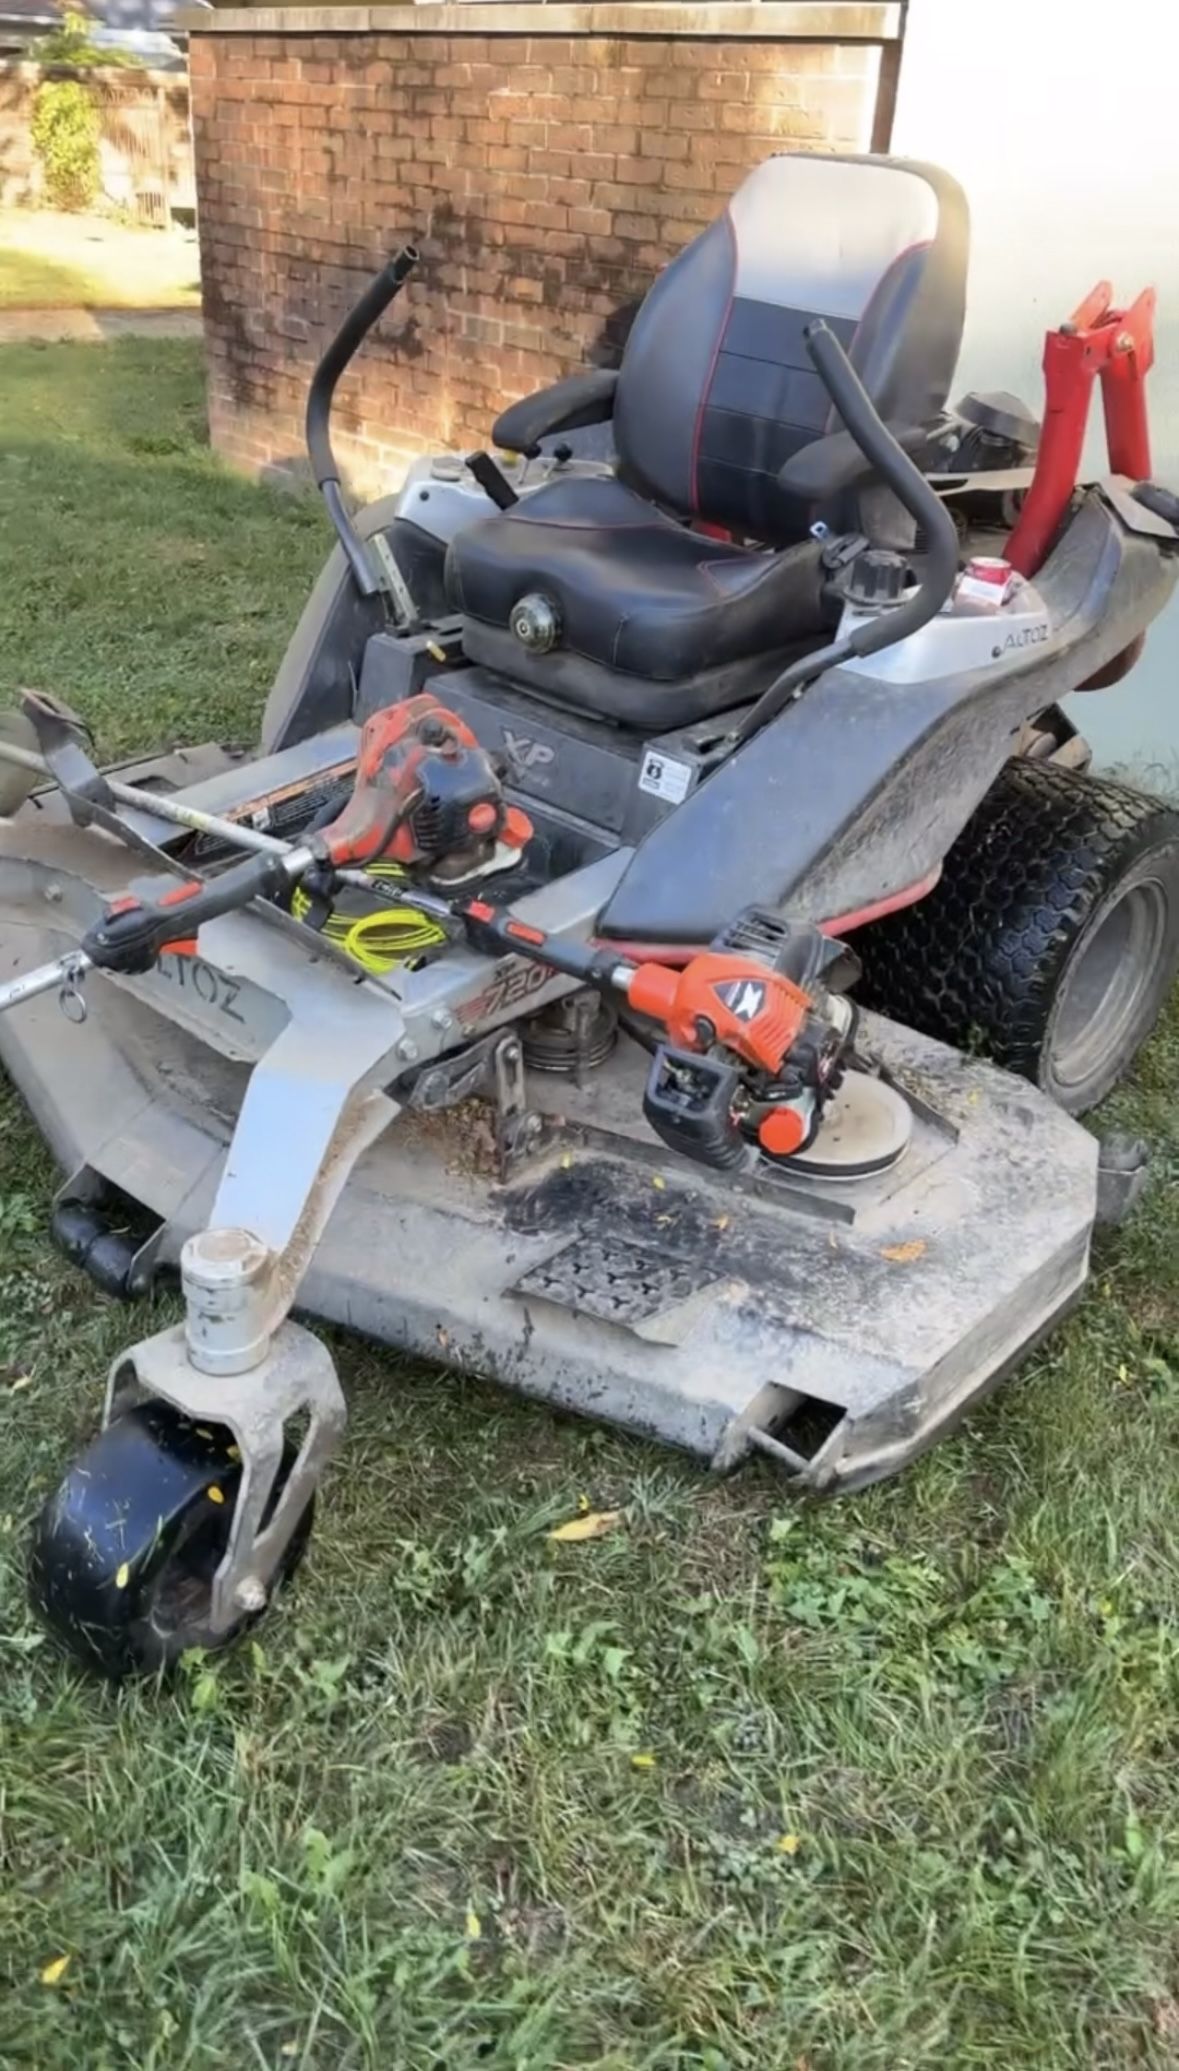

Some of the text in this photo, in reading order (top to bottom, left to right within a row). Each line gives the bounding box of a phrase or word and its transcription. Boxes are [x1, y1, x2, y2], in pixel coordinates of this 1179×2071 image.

[1003, 623, 1048, 650] ALTOZ
[501, 729, 556, 768] XP
[157, 954, 246, 1023] LTOZ
